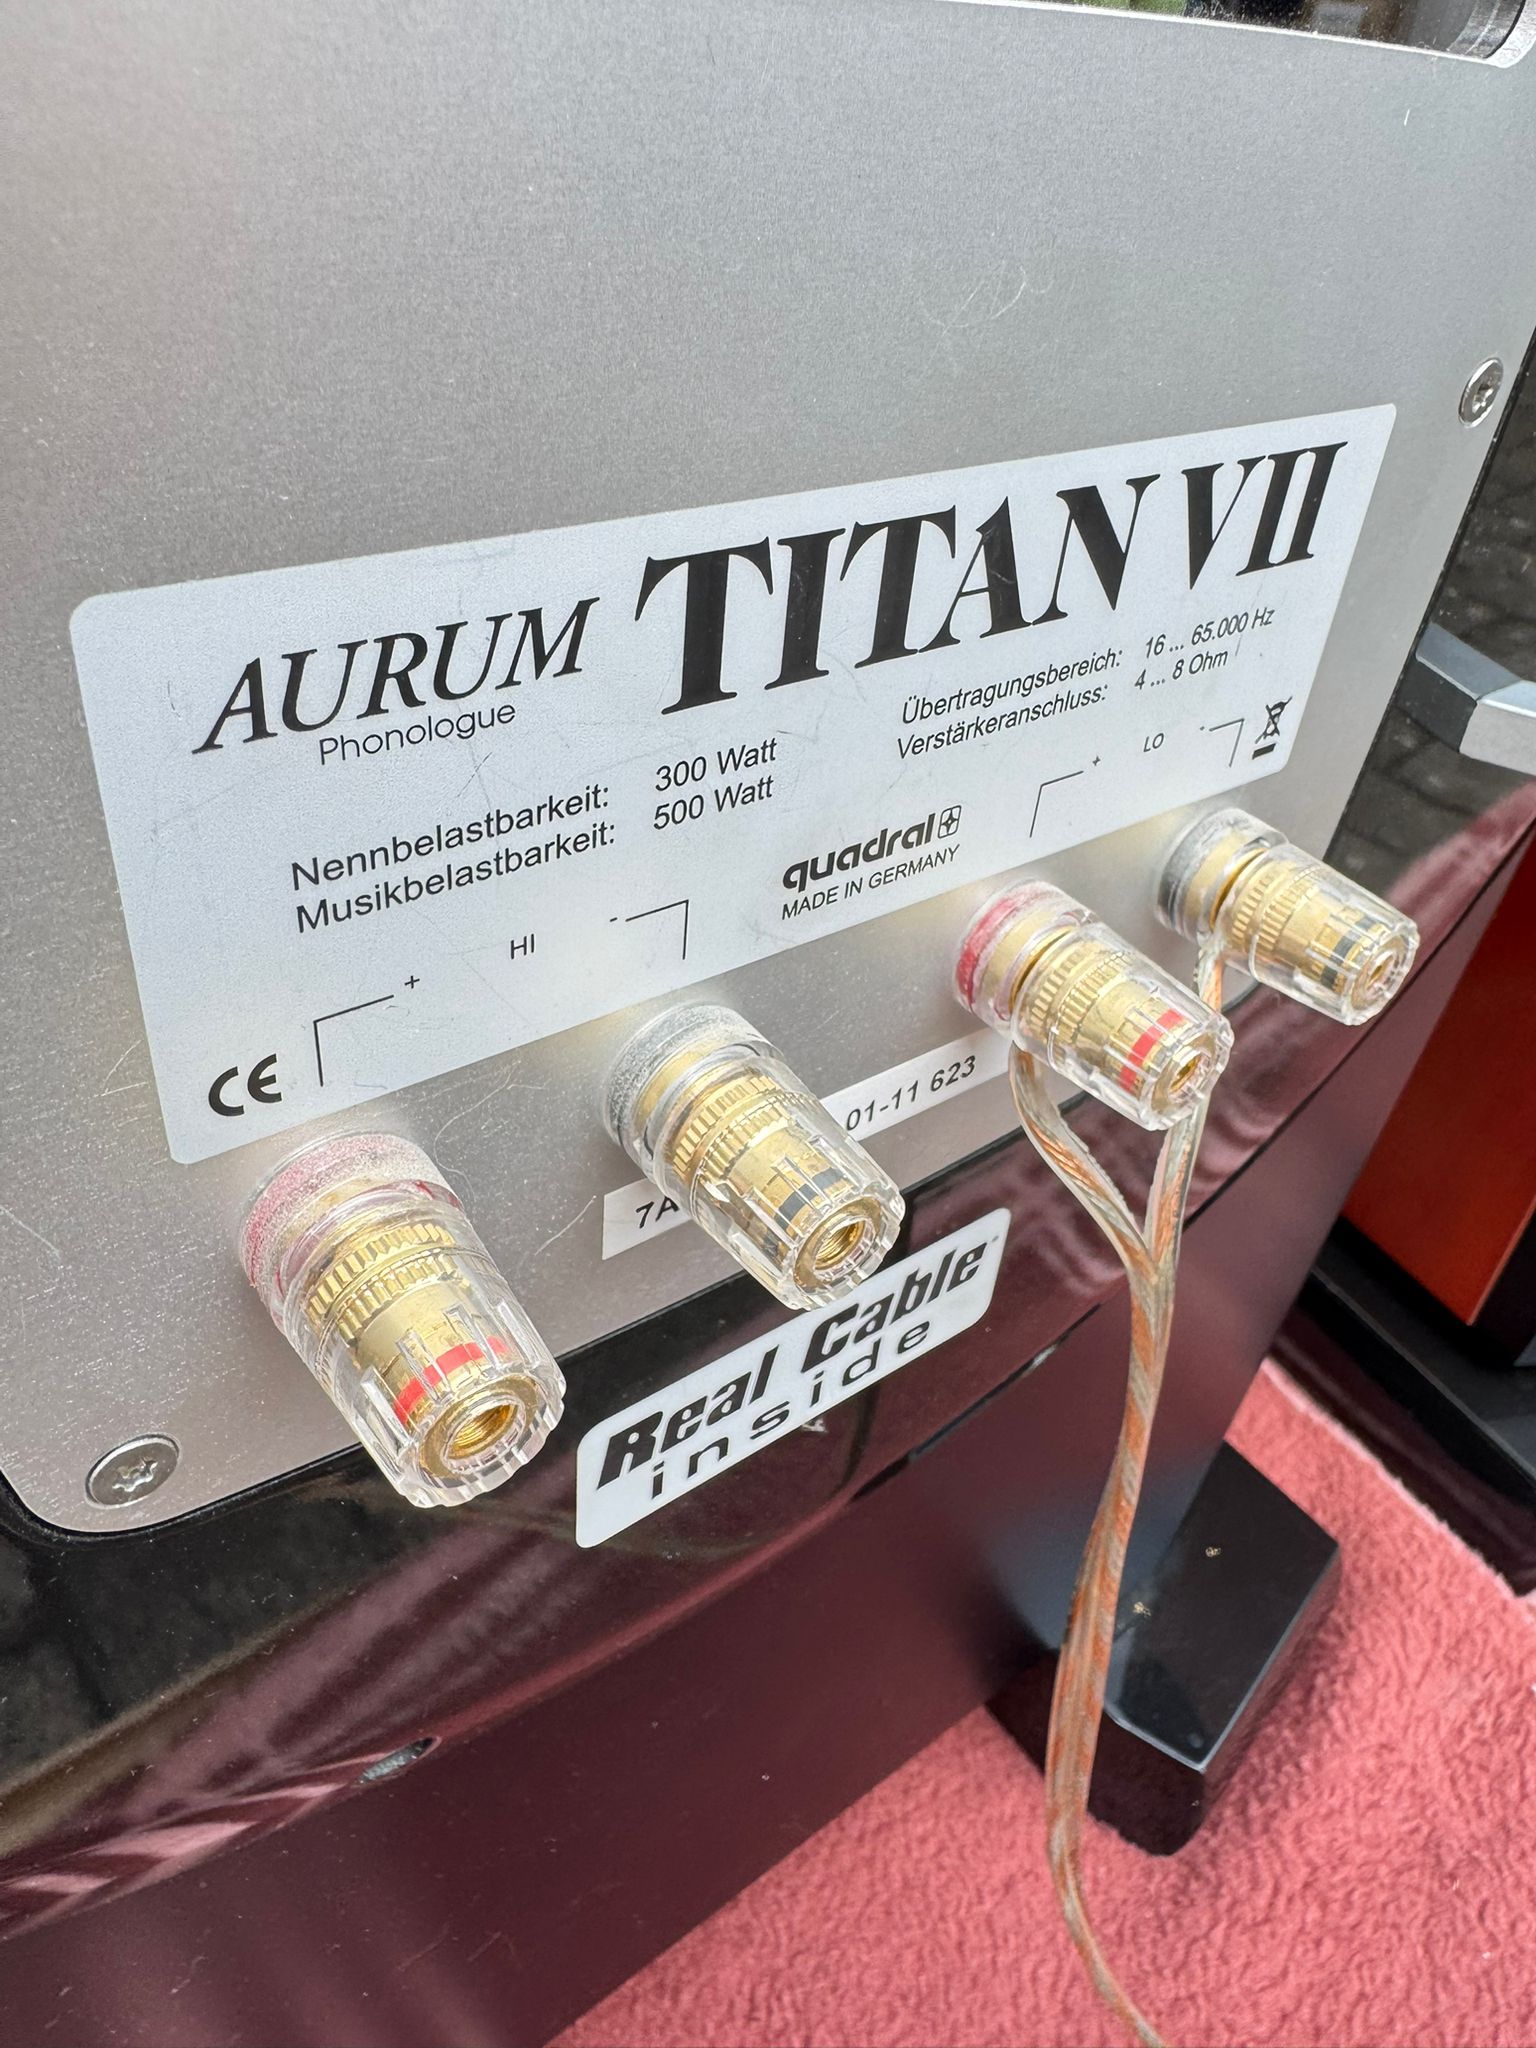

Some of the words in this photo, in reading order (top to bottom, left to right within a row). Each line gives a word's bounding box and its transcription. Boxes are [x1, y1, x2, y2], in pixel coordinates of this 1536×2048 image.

[192, 597, 600, 754] AURUM
[634, 473, 1161, 715] TITAN
[1181, 441, 1348, 590] VII
[897, 684, 1108, 760] Verstärkeranschluss:
[1134, 669, 1147, 690] 4
[1172, 659, 1184, 680] 8
[1188, 651, 1228, 675] Ohm
[902, 648, 1123, 725] Übertragungsbereich:
[1145, 634, 1167, 659] 16
[1191, 612, 1249, 646] 65.000
[1251, 607, 1275, 630] Hz
[319, 704, 516, 765] Phonologue
[1143, 733, 1165, 753] LO
[291, 784, 609, 891] Nennbelastbarkeit:
[655, 756, 707, 792] 300
[716, 738, 778, 775] Watt
[296, 821, 615, 934] Musikbelastbarkeit:
[653, 794, 704, 830] 500
[714, 775, 774, 813] Watt
[782, 813, 936, 893] quadral
[781, 886, 840, 920] MADE
[844, 877, 863, 899] IN
[868, 844, 960, 889] GERMANY
[510, 933, 535, 960] HI
[846, 1080, 919, 1131] 01-11
[930, 1055, 976, 1092] 623
[596, 1343, 780, 1491] Real
[800, 1242, 989, 1374] Cable
[651, 1320, 931, 1500] inside
